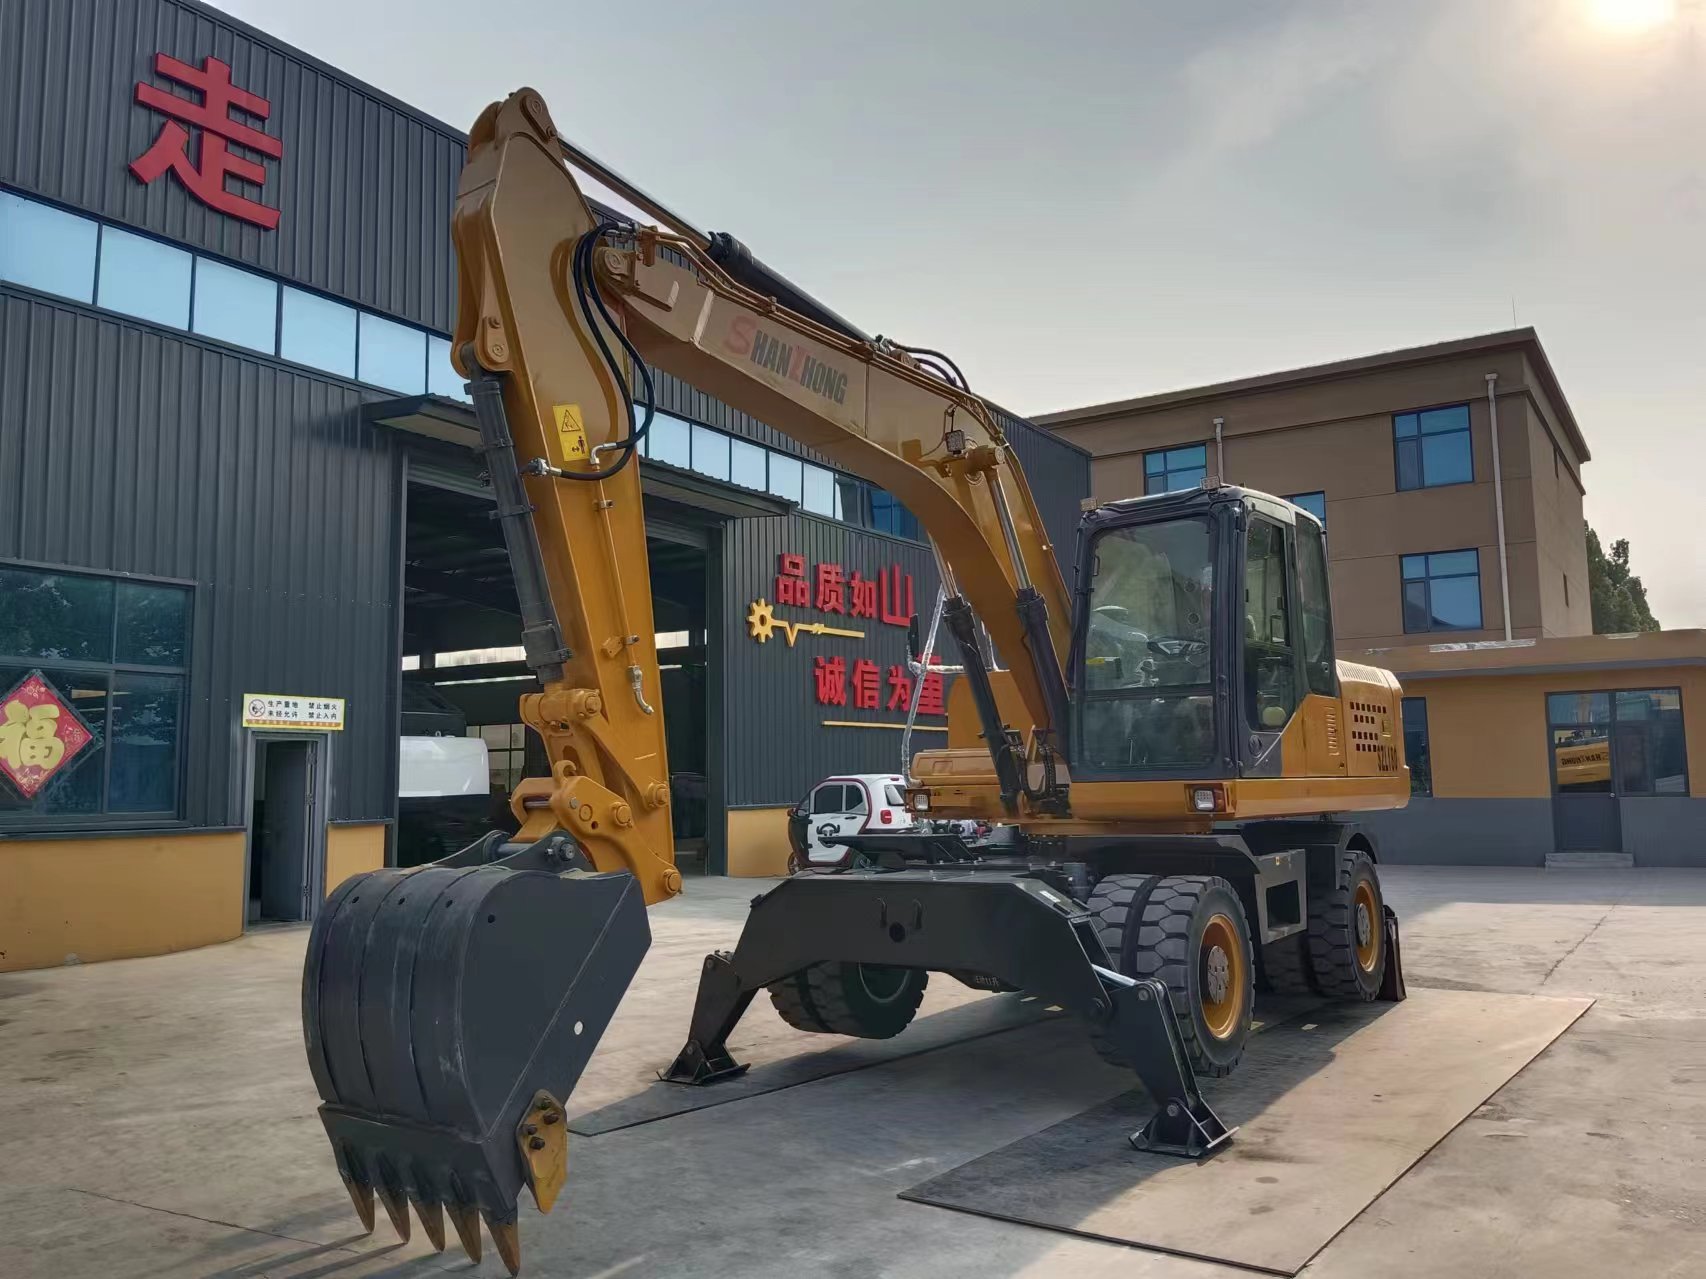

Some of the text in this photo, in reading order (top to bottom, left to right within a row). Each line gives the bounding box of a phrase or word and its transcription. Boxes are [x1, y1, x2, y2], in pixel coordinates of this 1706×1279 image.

[128, 52, 283, 229] 走
[722, 315, 848, 404] SHANZHONG
[775, 553, 915, 627] 品质如山
[267, 700, 337, 711] 生产重地 禁止烟火
[267, 710, 337, 719] 未经允许 禁止入内
[814, 653, 945, 715] 诚信为重
[0, 699, 65, 770] 福
